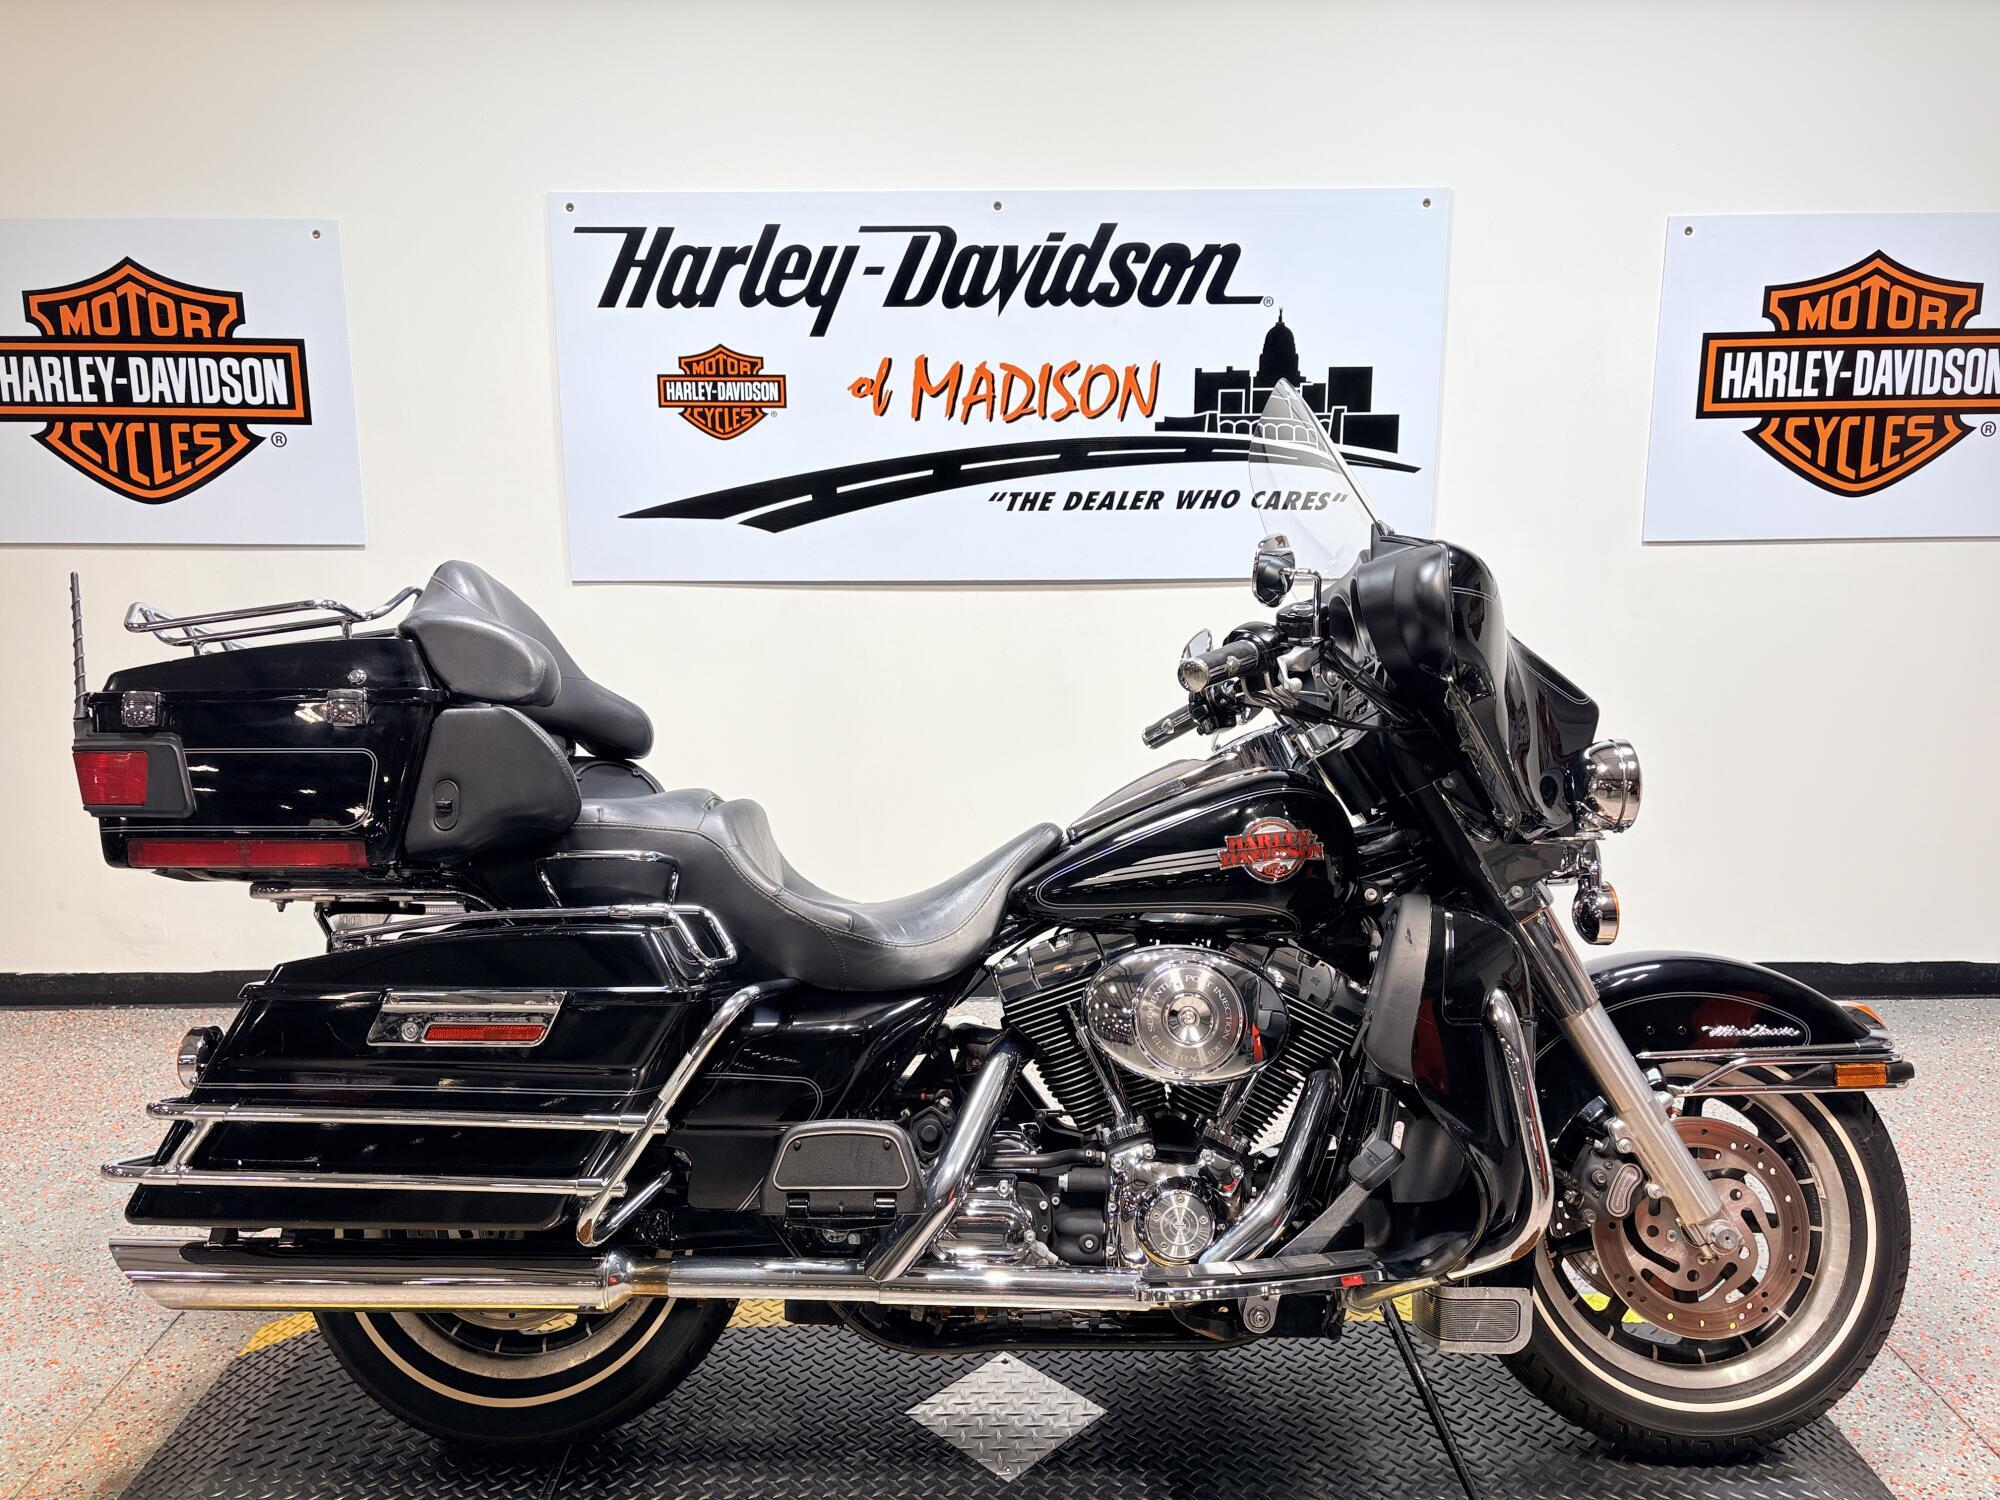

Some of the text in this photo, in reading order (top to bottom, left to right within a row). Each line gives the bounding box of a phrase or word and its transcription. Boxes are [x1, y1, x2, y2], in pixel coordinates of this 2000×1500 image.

[574, 223, 1264, 336] Harley-Davidson
[1797, 274, 1948, 331] MOTOR
[59, 281, 211, 338] MOTOR
[0, 356, 289, 405] HARLEY-DAVIDSON
[665, 381, 779, 401] HARLEY-DAVIDSON
[692, 353, 751, 375] MOTOR
[847, 354, 1160, 425] of MADISON
[1720, 347, 2000, 399] HARLEY-DAVIDSON
[693, 407, 752, 433] CYCLES
[1785, 415, 1935, 480] CYCLES
[71, 422, 222, 486] CYCLES
[1062, 491, 1165, 511] DEALER
[1175, 490, 1241, 510] WHO
[1146, 975, 1232, 1040] SEQUENTI POT INJECTION
